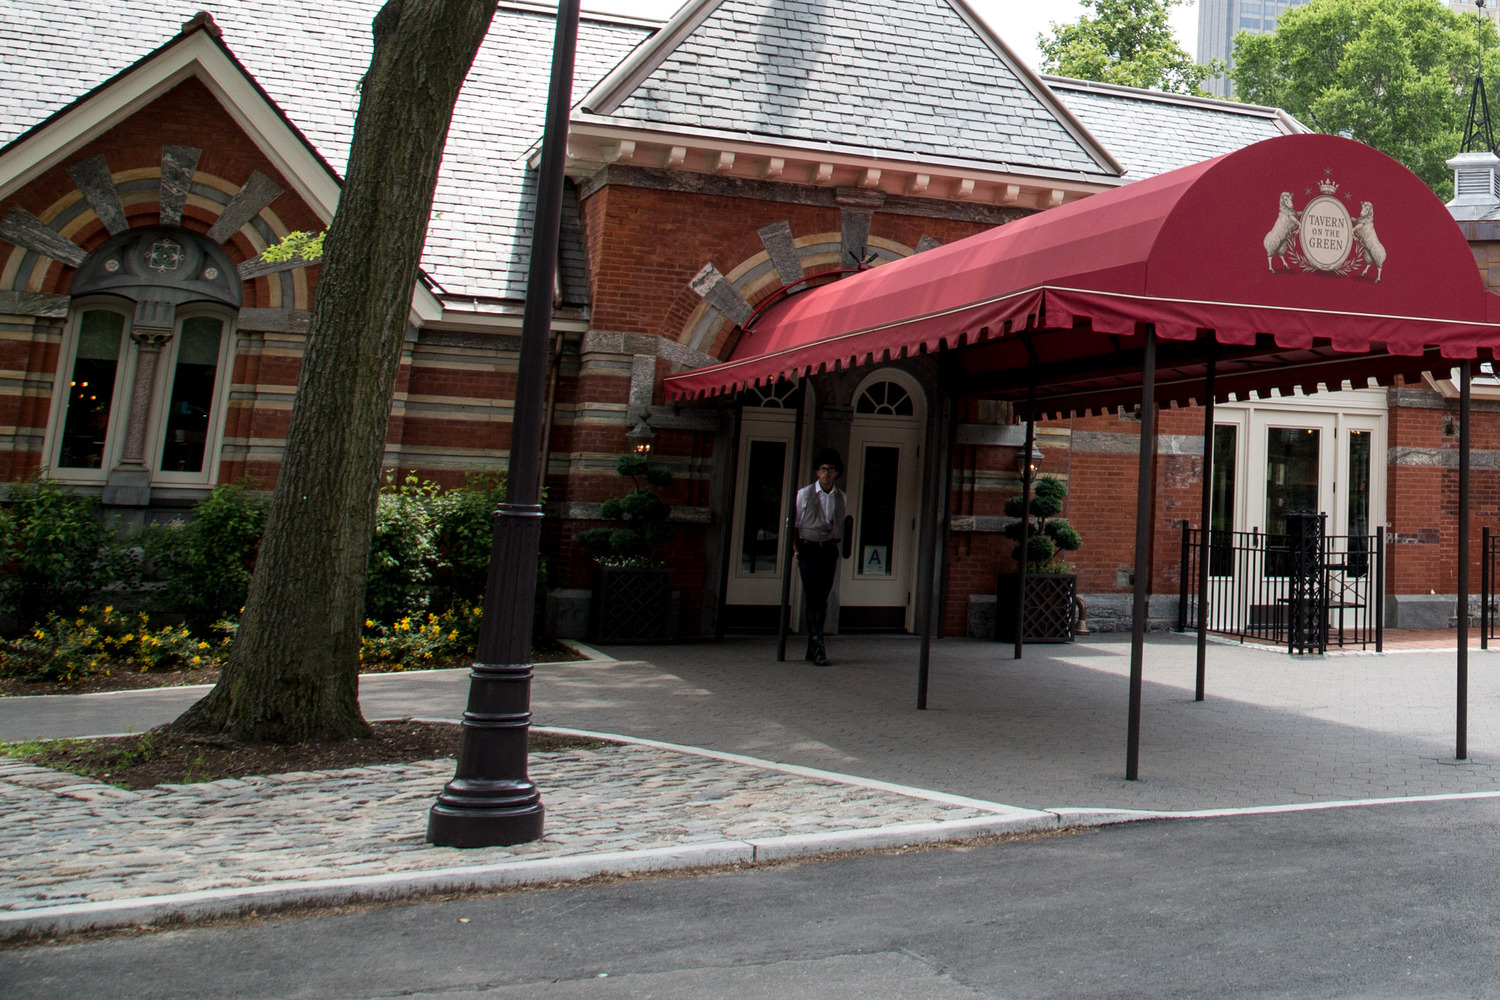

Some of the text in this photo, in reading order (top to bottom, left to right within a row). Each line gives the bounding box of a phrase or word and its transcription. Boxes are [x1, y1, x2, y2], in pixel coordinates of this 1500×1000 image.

[1309, 215, 1344, 228] TAVERN
[1312, 227, 1340, 237] ON THE
[1309, 237, 1343, 250] GREEN
[868, 549, 881, 565] A
